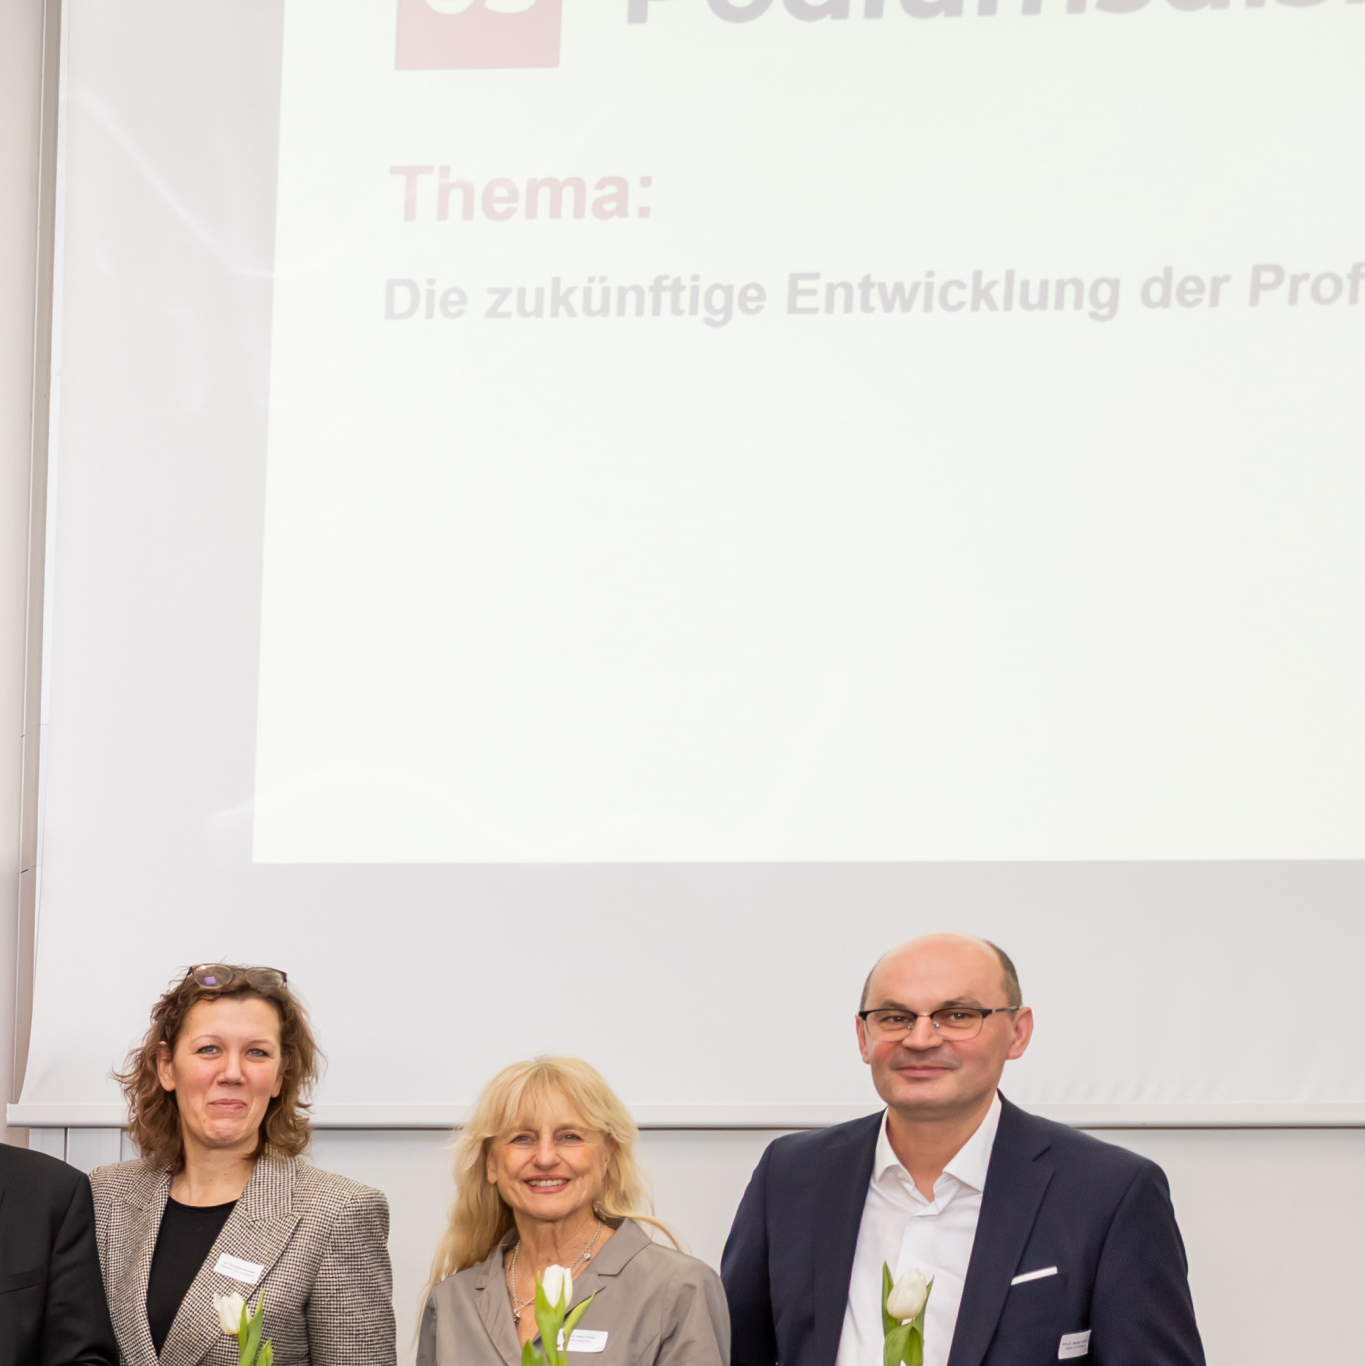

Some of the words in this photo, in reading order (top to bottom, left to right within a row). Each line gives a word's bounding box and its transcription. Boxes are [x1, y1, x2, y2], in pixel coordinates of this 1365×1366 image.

[389, 164, 653, 222] Thema:
[384, 277, 468, 320] Die
[485, 274, 767, 328] zukünftige
[785, 267, 1121, 322] Entwicklung
[1139, 264, 1232, 310] der
[1248, 261, 1365, 307] Prof
